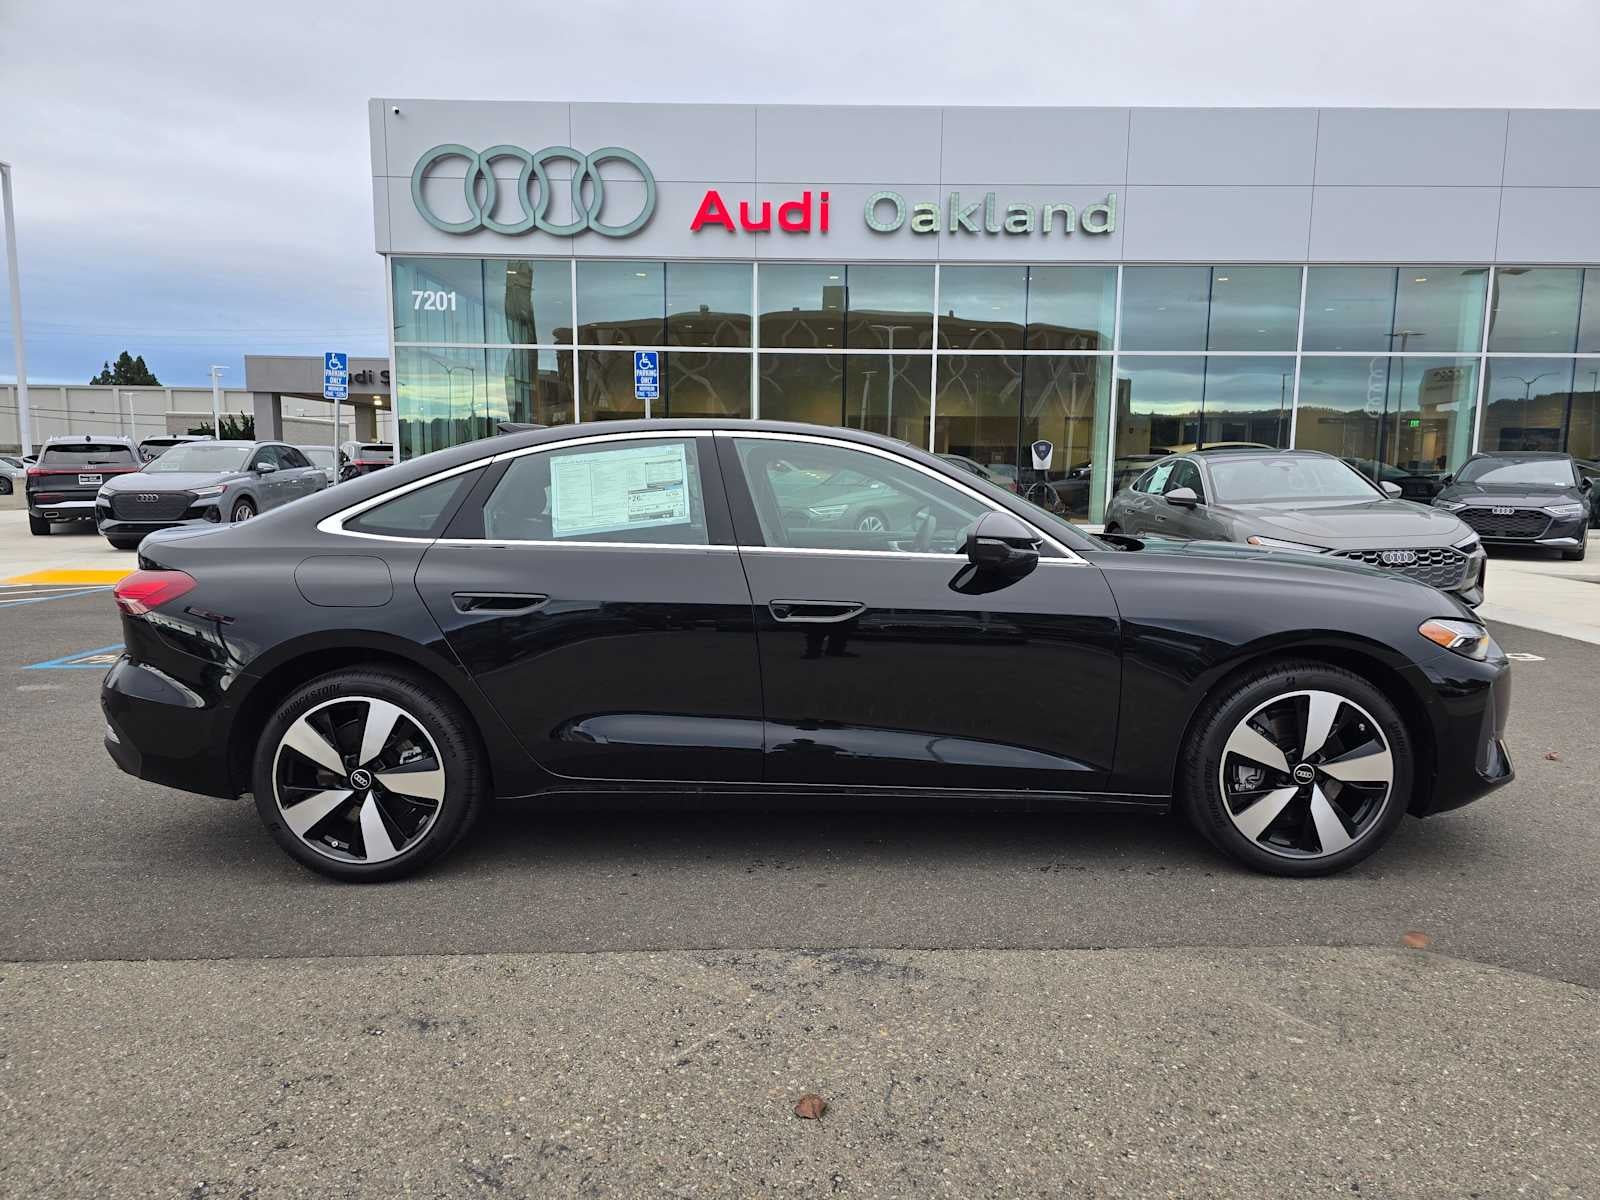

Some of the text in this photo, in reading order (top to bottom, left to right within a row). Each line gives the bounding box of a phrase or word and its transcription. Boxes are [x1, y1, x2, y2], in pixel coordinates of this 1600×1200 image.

[690, 190, 1119, 234] Audi Oakland
[412, 290, 457, 311] 7201
[326, 369, 346, 377] PARKING
[329, 376, 342, 384] ONLY
